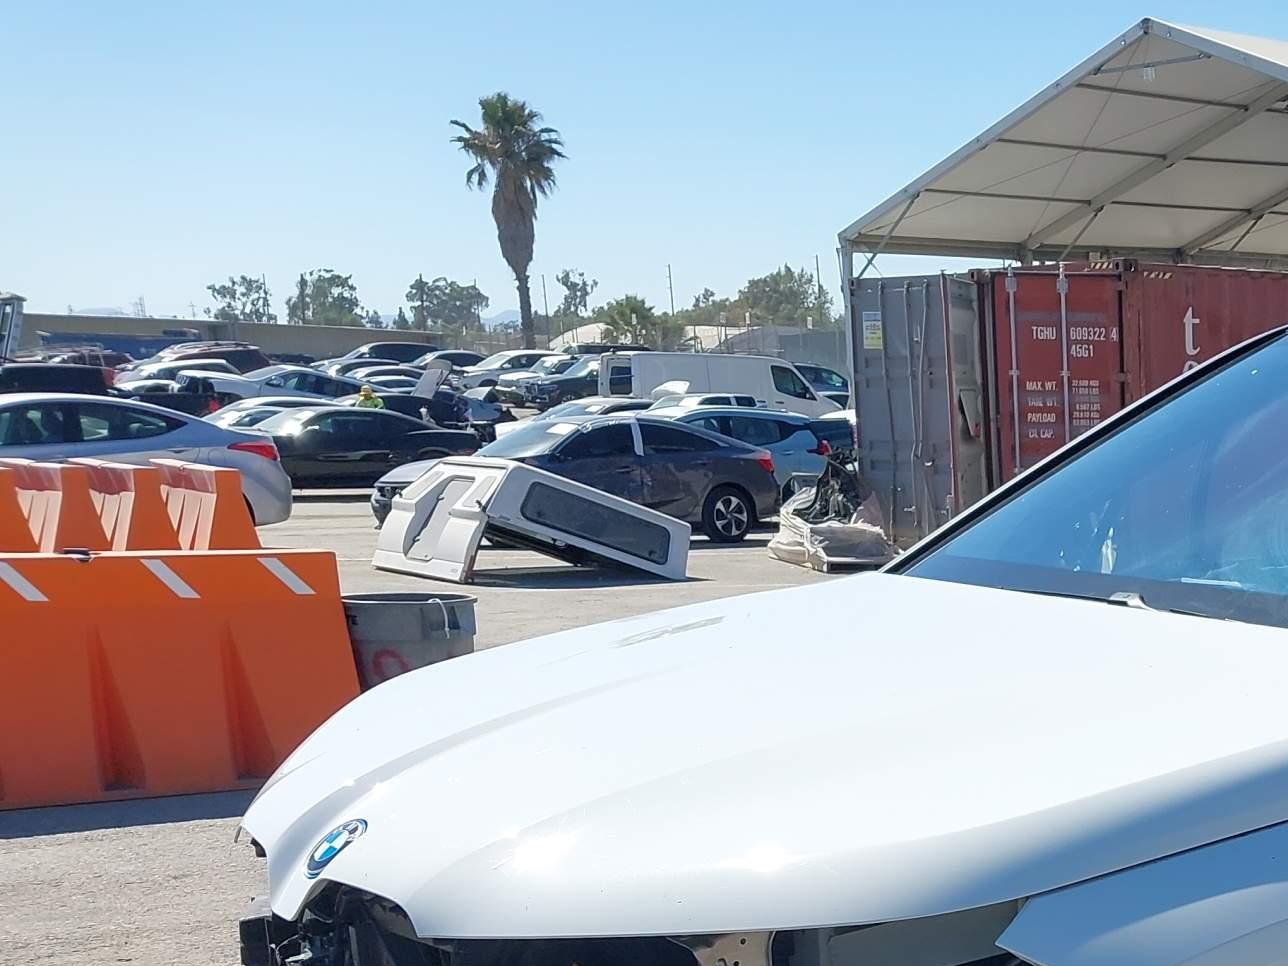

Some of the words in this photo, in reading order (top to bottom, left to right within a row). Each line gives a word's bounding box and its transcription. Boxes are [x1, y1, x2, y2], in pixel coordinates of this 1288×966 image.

[1032, 326, 1056, 339] TGHU
[1070, 327, 1106, 340] 609322
[1111, 327, 1119, 341] 4
[1070, 344, 1094, 357] 45G1
[1027, 413, 1056, 422] PAYLOAD
